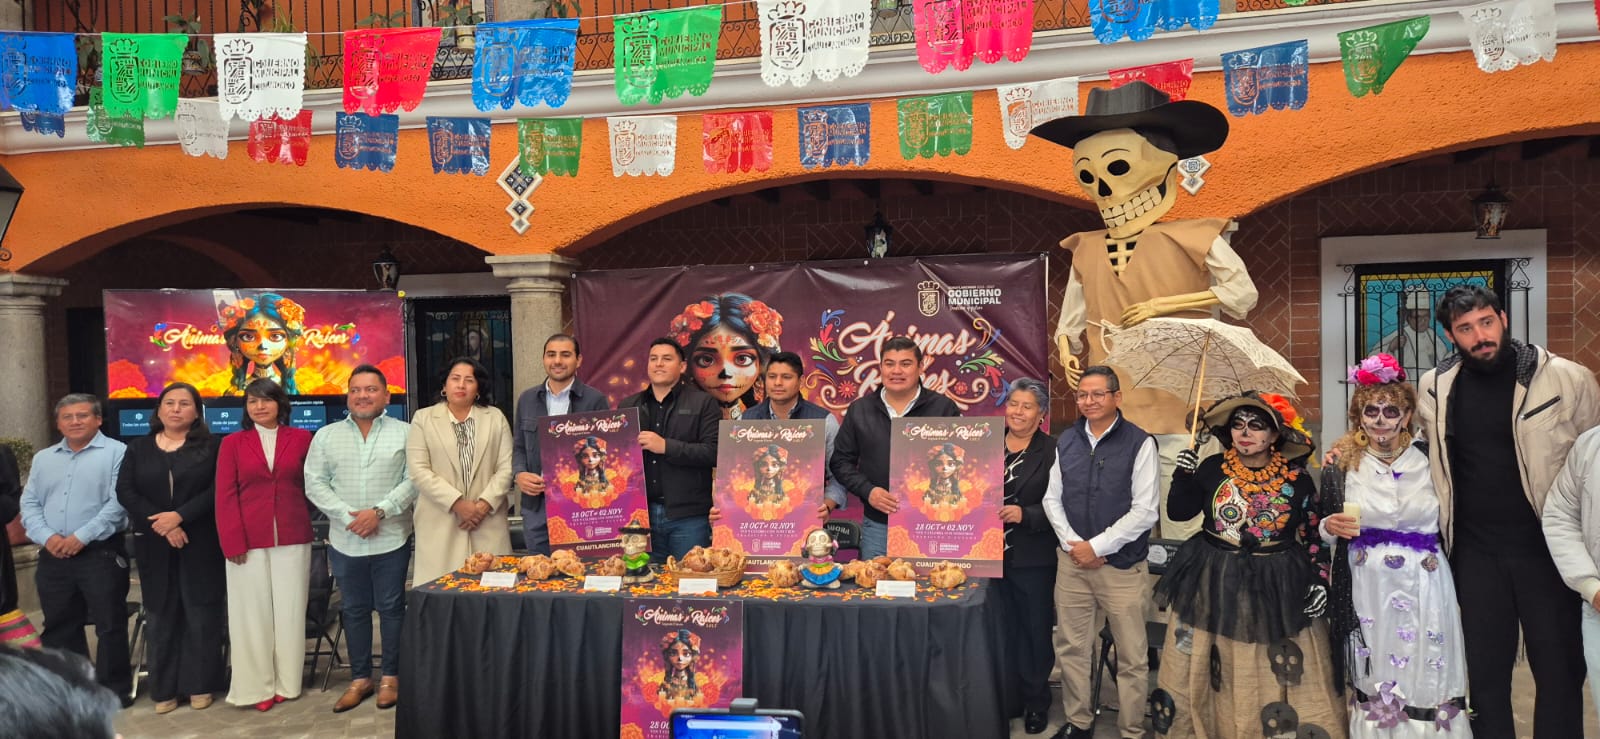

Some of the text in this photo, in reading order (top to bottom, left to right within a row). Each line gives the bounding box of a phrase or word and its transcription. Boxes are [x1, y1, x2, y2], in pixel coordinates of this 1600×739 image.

[806, 12, 865, 30] GOBIERNO
[806, 21, 865, 39] MUNICIPAL
[947, 288, 1002, 298] GOBIERNO
[947, 296, 1002, 305] MUNICIPAL
[838, 310, 977, 358] Ámas
[749, 522, 764, 530] OCT
[777, 522, 796, 530] NOV
[915, 523, 925, 531] 28
[925, 523, 941, 531] OCT
[955, 523, 975, 531] NOV
[576, 543, 623, 551] CUAUTLANCING
[649, 721, 660, 729] 28
